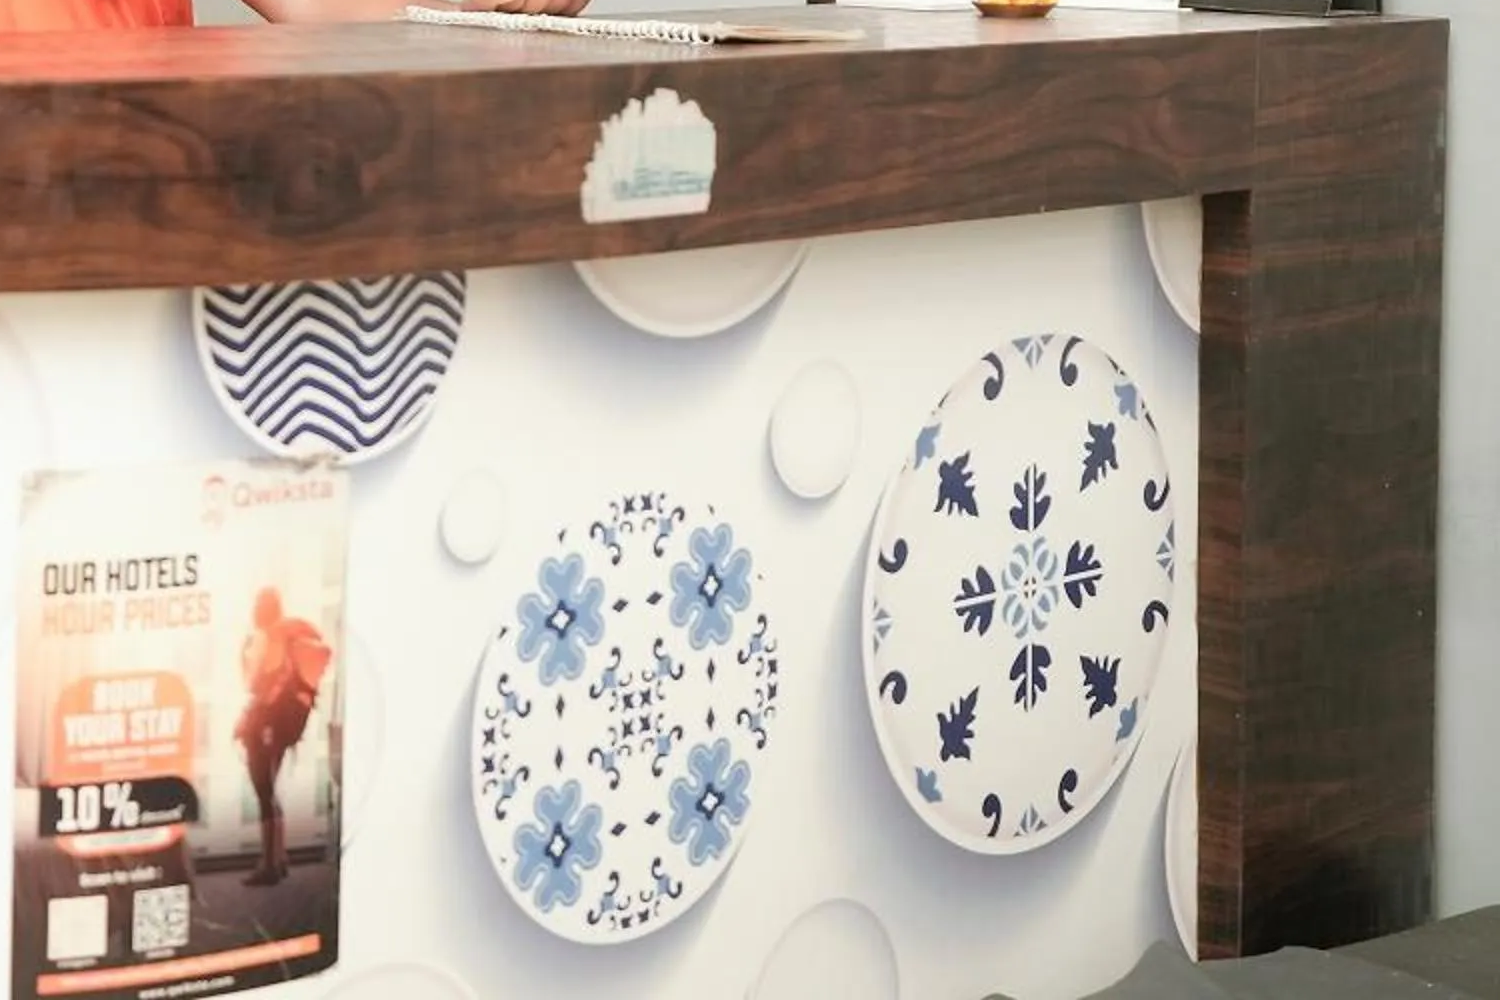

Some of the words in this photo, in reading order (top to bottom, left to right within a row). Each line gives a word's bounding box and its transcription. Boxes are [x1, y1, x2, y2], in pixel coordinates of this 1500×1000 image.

[43, 561, 97, 596] OUR
[105, 554, 199, 593] HOTELS
[41, 600, 115, 636] HOUR
[125, 591, 212, 631] PRICES
[56, 780, 140, 832] 10%
